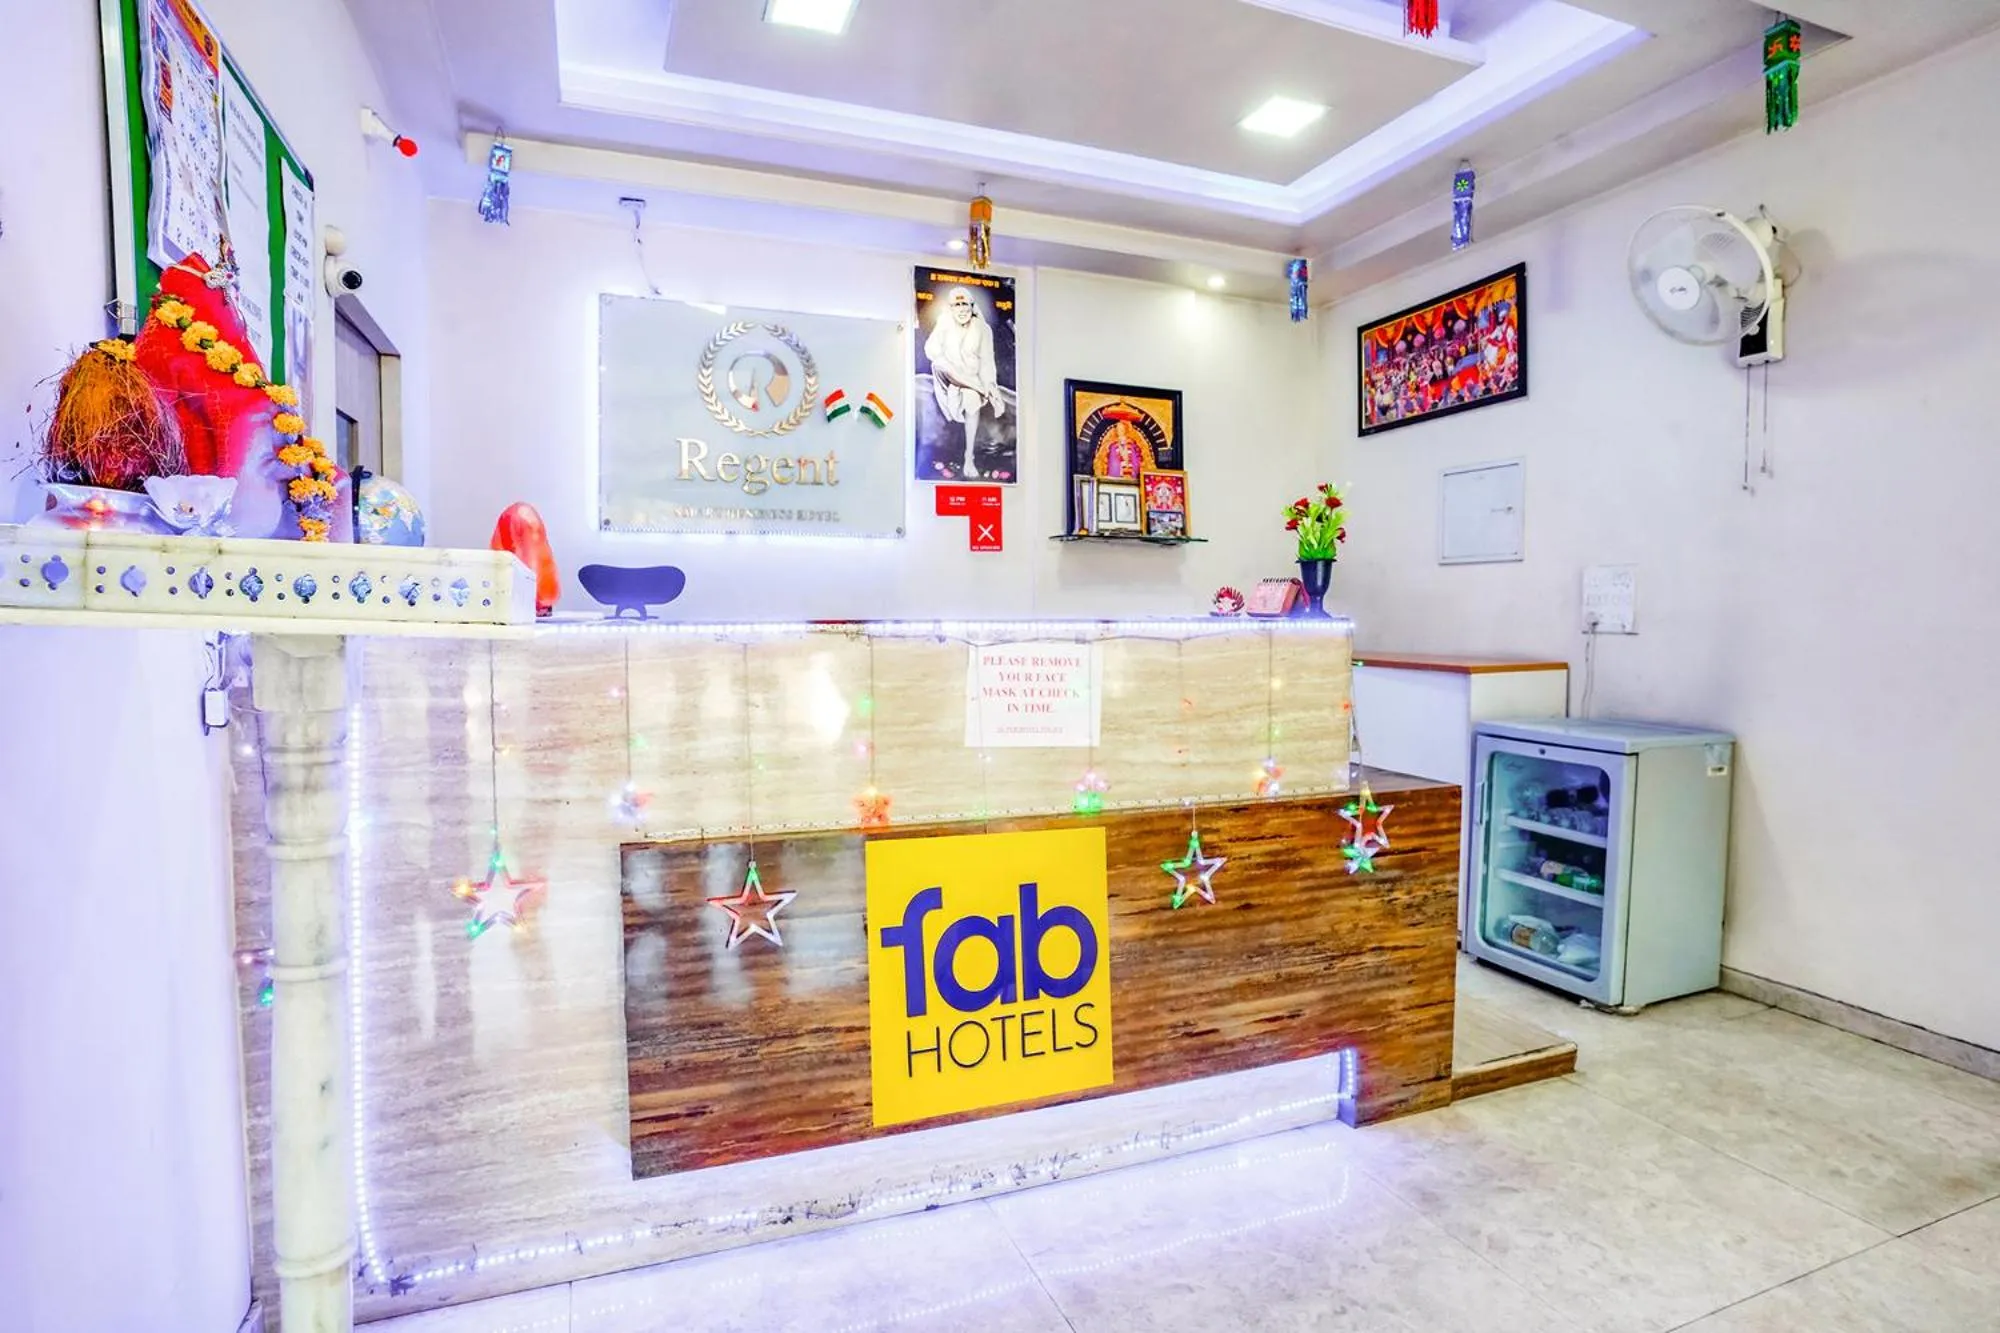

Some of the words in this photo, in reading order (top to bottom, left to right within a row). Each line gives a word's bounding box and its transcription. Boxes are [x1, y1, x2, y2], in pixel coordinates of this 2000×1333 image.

[675, 437, 840, 496] Regent
[982, 656, 1028, 666] PLEASE
[1031, 656, 1081, 667] REMOVE
[998, 671, 1033, 682] YOUR
[1036, 672, 1067, 682] FACE
[982, 687, 1016, 698] MASK
[1021, 687, 1035, 698] AT
[1039, 687, 1081, 699] CHECK
[1006, 703, 1020, 713] IN
[880, 882, 1098, 1018] fab
[906, 1002, 1099, 1078] HOTELS
